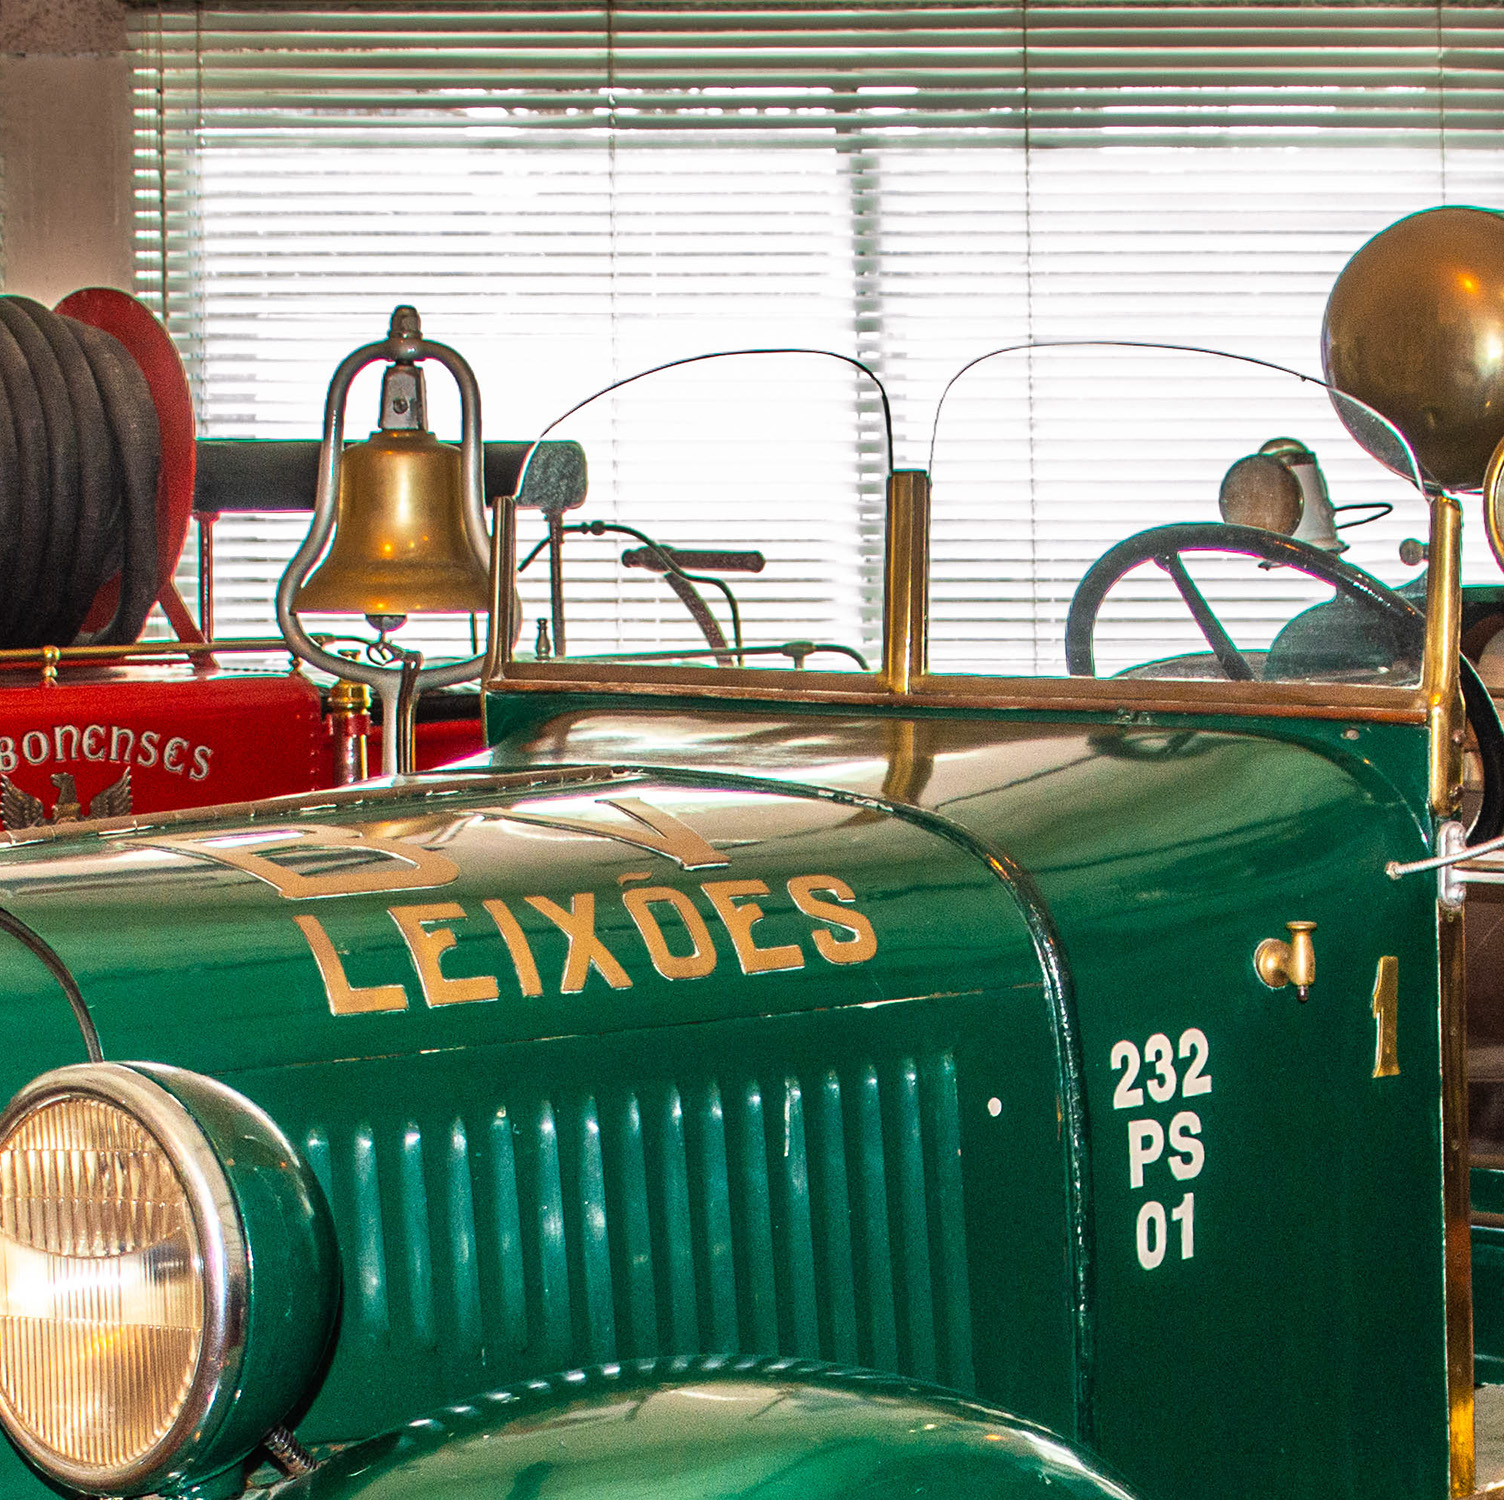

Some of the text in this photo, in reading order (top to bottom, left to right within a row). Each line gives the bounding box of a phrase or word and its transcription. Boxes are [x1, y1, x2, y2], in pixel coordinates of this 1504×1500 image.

[295, 869, 879, 1017] LEIXÕES
[1110, 1027, 1212, 1111] 232
[1128, 1110, 1206, 1189] PS
[1136, 1192, 1195, 1271] 01
